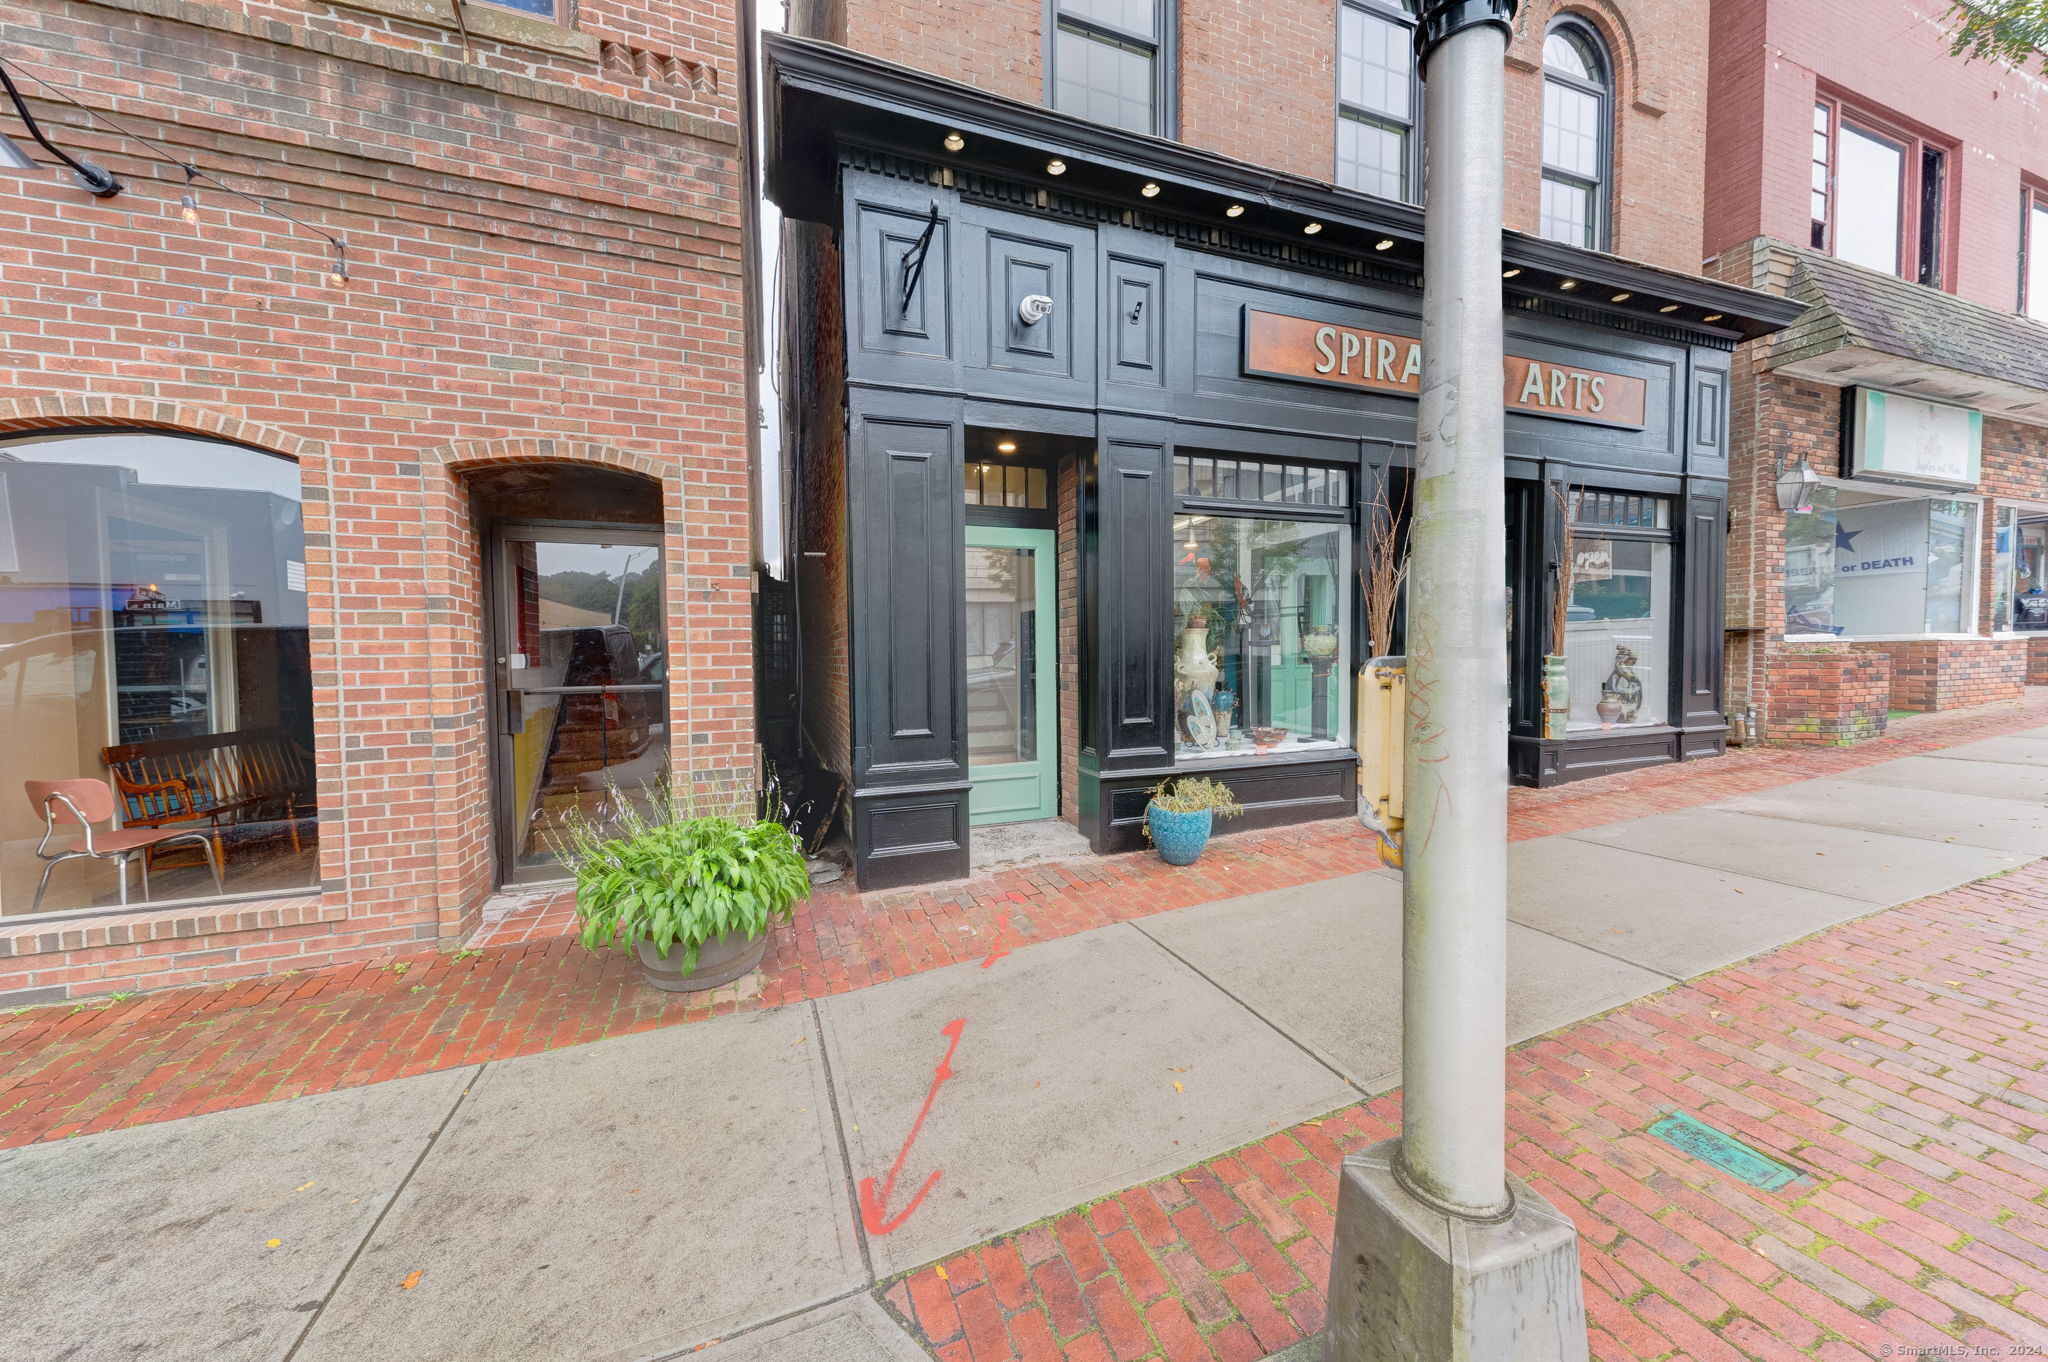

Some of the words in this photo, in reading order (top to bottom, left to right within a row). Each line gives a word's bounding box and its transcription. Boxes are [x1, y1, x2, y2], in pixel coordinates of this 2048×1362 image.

[1520, 362, 1605, 412] ARTS
[1841, 564, 1857, 572] or
[1861, 556, 1914, 571] DEATH
